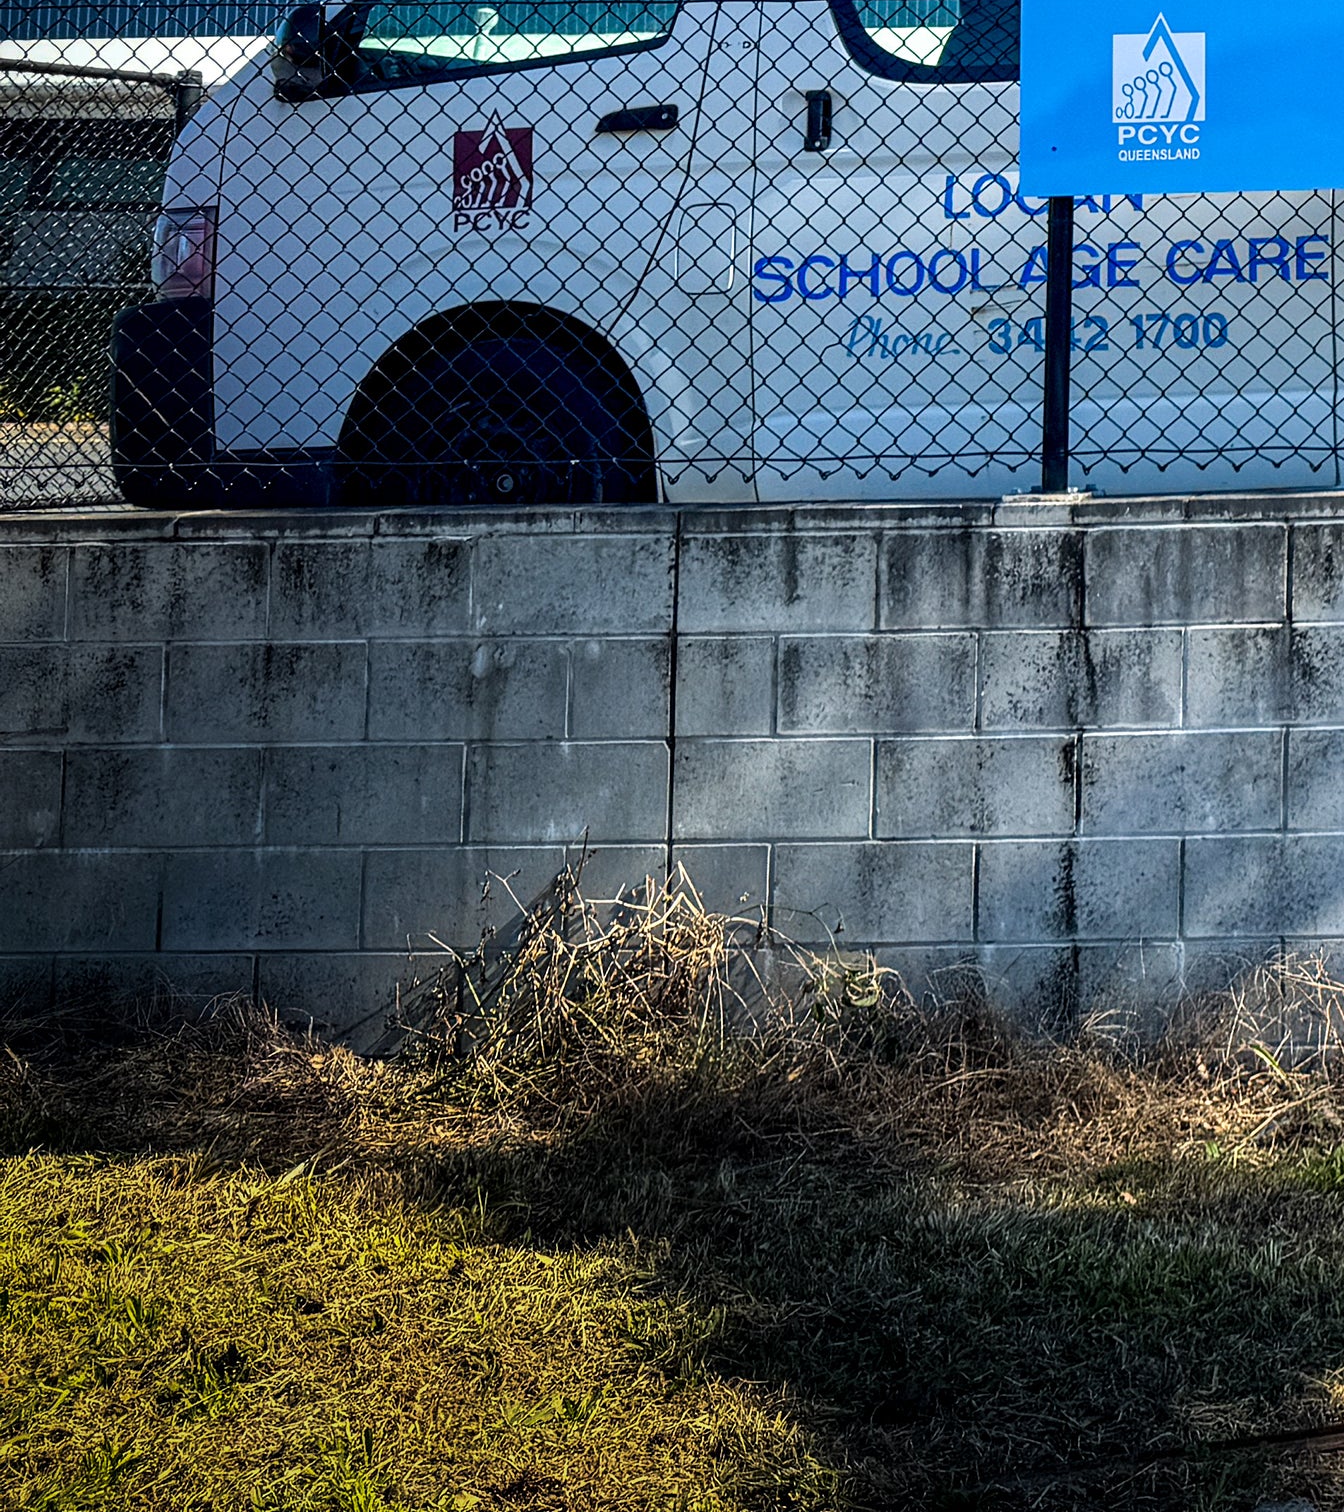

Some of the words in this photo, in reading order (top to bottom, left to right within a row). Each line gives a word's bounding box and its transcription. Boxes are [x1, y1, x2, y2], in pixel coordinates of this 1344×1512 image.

[1118, 124, 1200, 145] PCYC
[1118, 148, 1200, 161] QUEENSLAND
[453, 210, 531, 233] PCYC
[752, 246, 995, 304] SCHOOL
[1018, 241, 1141, 289] AGE
[1165, 233, 1330, 285] CARE
[987, 314, 1109, 355] 342
[1129, 312, 1229, 351] 1700
